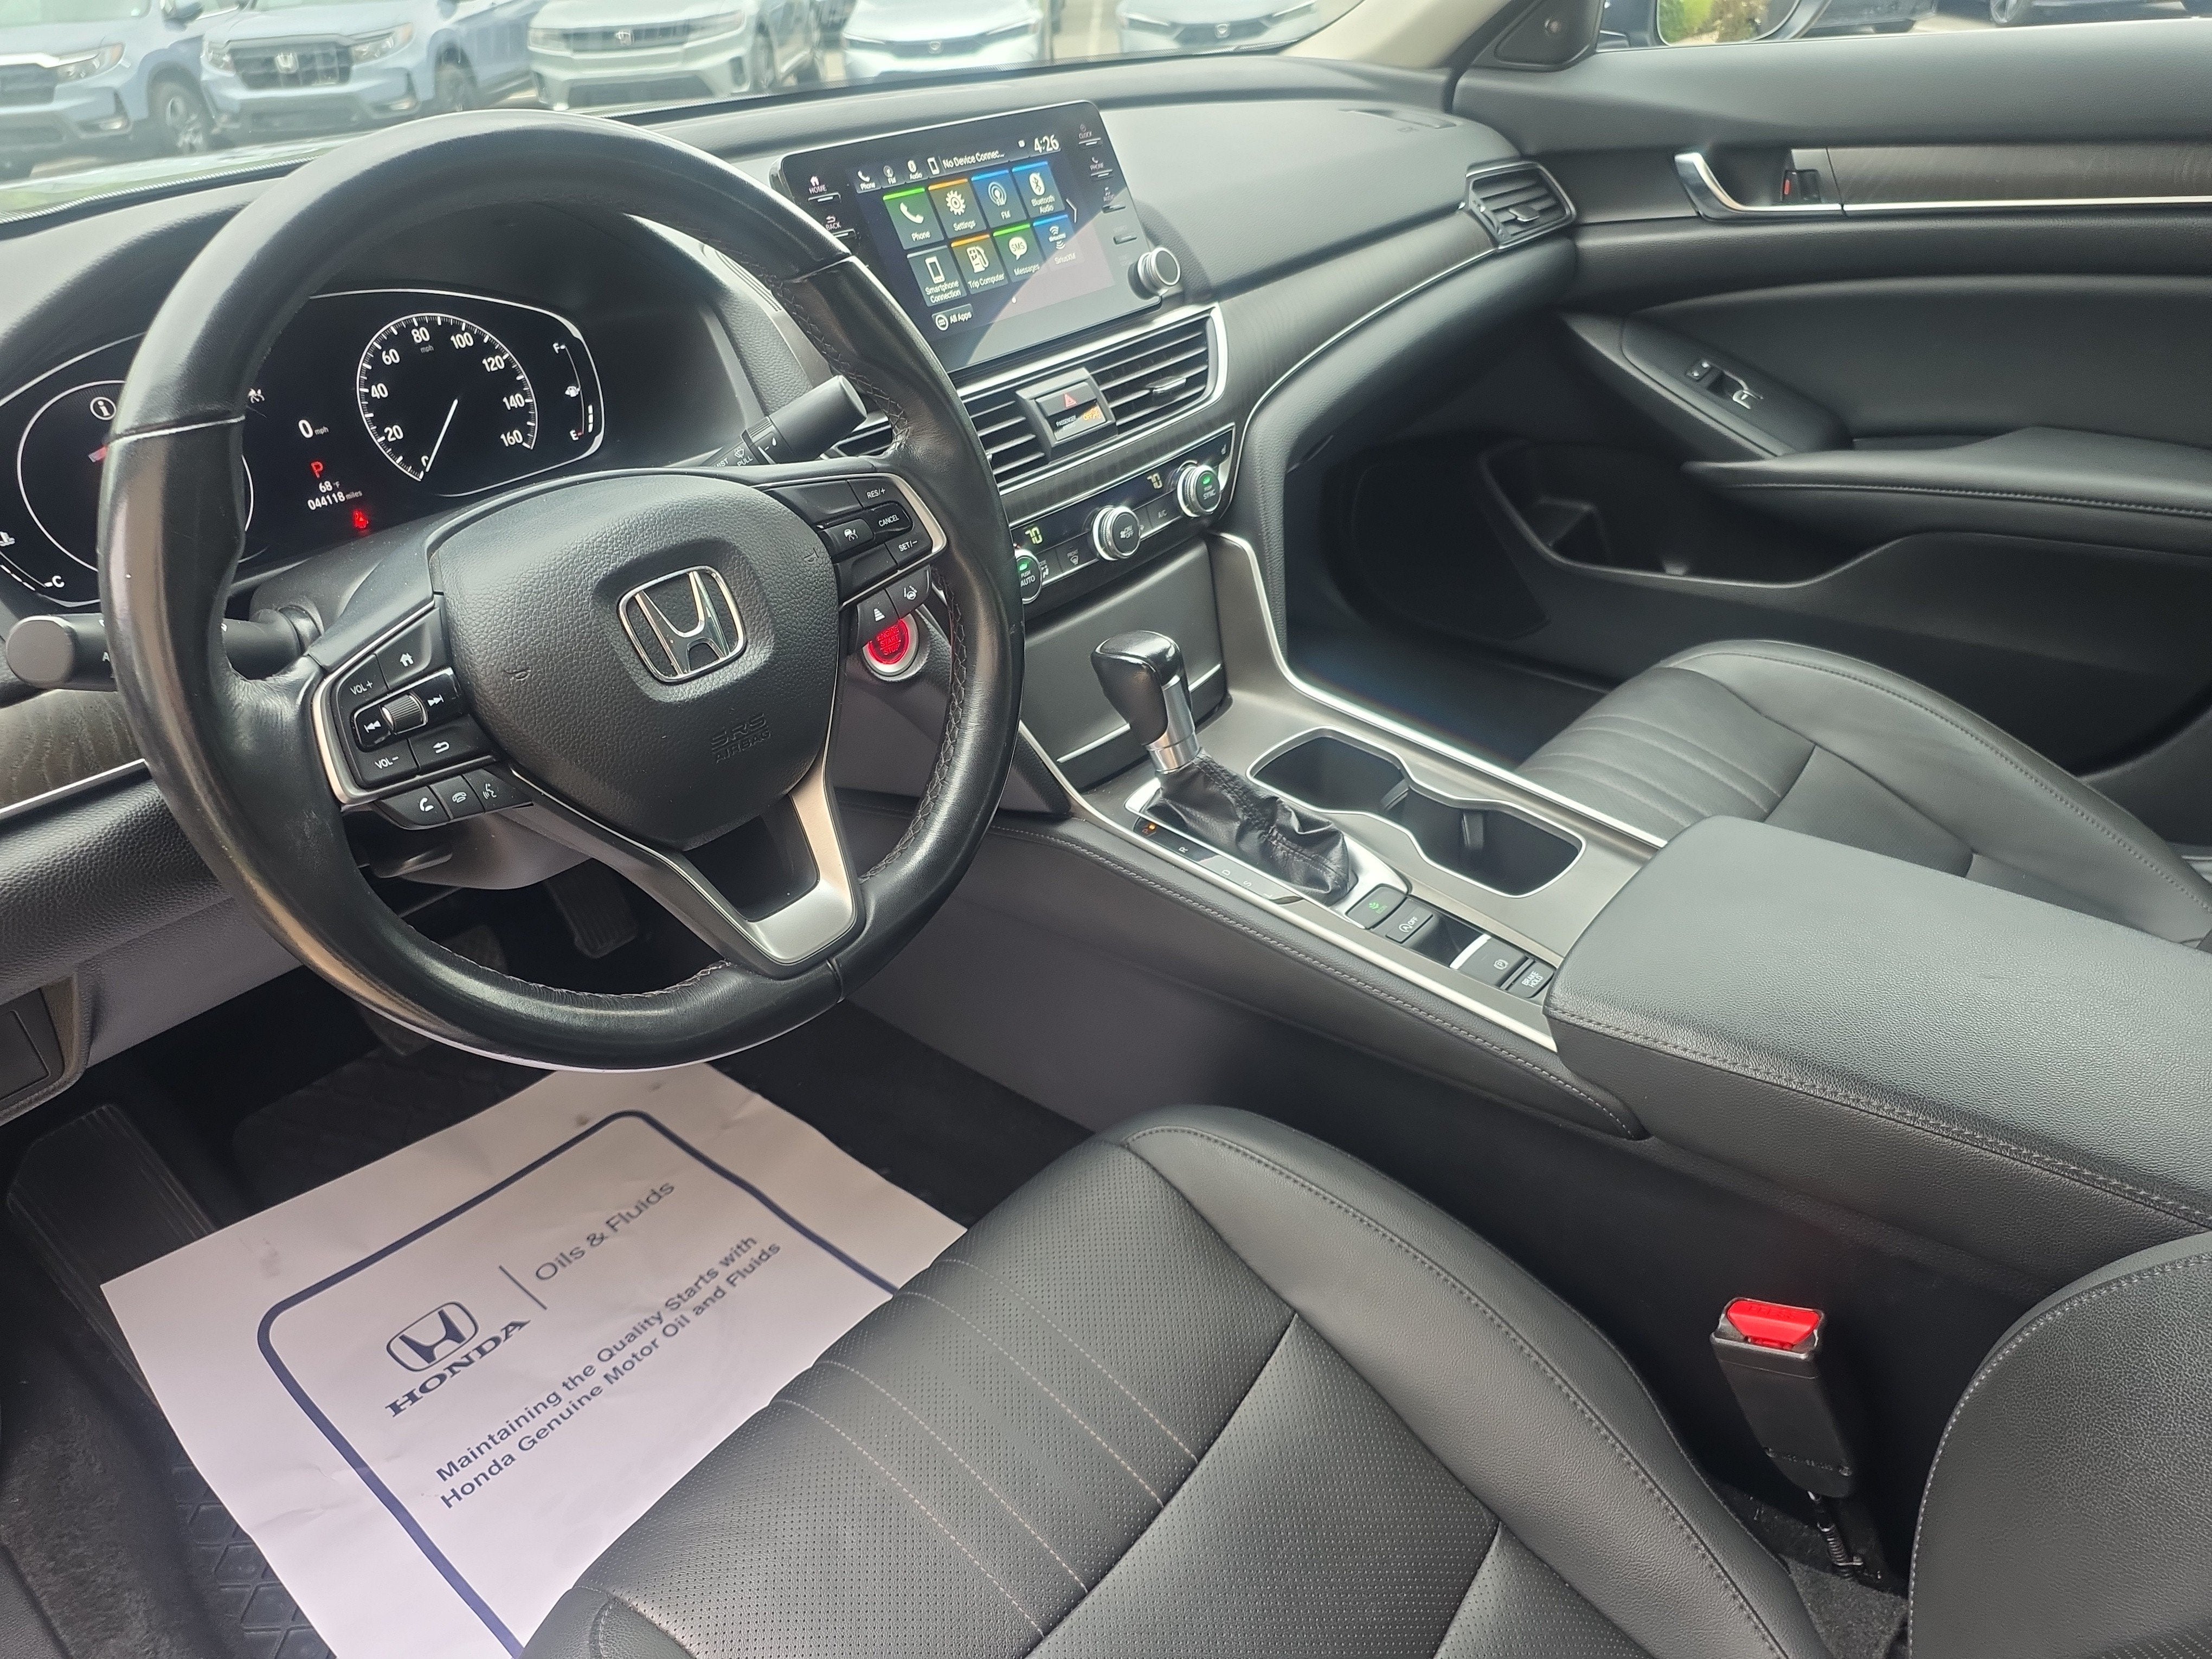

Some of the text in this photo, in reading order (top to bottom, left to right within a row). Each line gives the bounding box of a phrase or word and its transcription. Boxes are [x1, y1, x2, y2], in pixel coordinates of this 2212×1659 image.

[1034, 134, 1059, 153] 4:26
[942, 158, 954, 169] No
[954, 154, 976, 166] Device
[809, 185, 827, 194] HOME
[860, 182, 876, 190] Phone
[1031, 196, 1056, 206] Bluetooth
[1001, 210, 1011, 220] FM
[1040, 204, 1054, 214] Audio
[826, 221, 841, 230] BACK
[954, 220, 975, 231] Settings
[912, 231, 930, 241] Phone
[1012, 242, 1025, 252] SMS
[1014, 263, 1040, 276] Messages
[925, 280, 959, 295] Smartphone
[968, 273, 1005, 290] Trip Computer
[930, 290, 961, 304] Connection
[949, 311, 972, 324] All Apps
[411, 326, 430, 344] 80
[451, 332, 474, 349] 100
[420, 344, 434, 353] mph
[382, 349, 401, 365] 60
[482, 355, 505, 372] 120
[371, 383, 389, 400] 40
[503, 394, 525, 410] 140
[298, 419, 329, 438] 0 mph
[384, 425, 404, 442] 20
[500, 429, 523, 447] 160
[737, 456, 753, 467] PULL
[311, 461, 324, 478] P
[319, 480, 333, 493] 68
[1147, 473, 1163, 489] 70
[307, 490, 363, 510] 044118 miles
[867, 487, 886, 499] RES/+
[878, 514, 899, 528] CANCEL
[1025, 526, 1043, 544] 70
[1020, 575, 1036, 587] AUTO
[1021, 570, 1031, 578] PUSH
[52, 575, 65, 588] C
[877, 625, 899, 641] ENGINE
[880, 634, 899, 647] START
[884, 644, 899, 655] STOP
[1521, 970, 1539, 986] BRAKE
[1528, 975, 1544, 988] HOLD
[535, 1180, 676, 1282] Oils & Fluids
[435, 1234, 758, 1482] Maintaining the Quality Starts with
[384, 1320, 531, 1418] HONDA
[440, 1242, 782, 1508] Honda Genuine Motor Oil and Fluids
